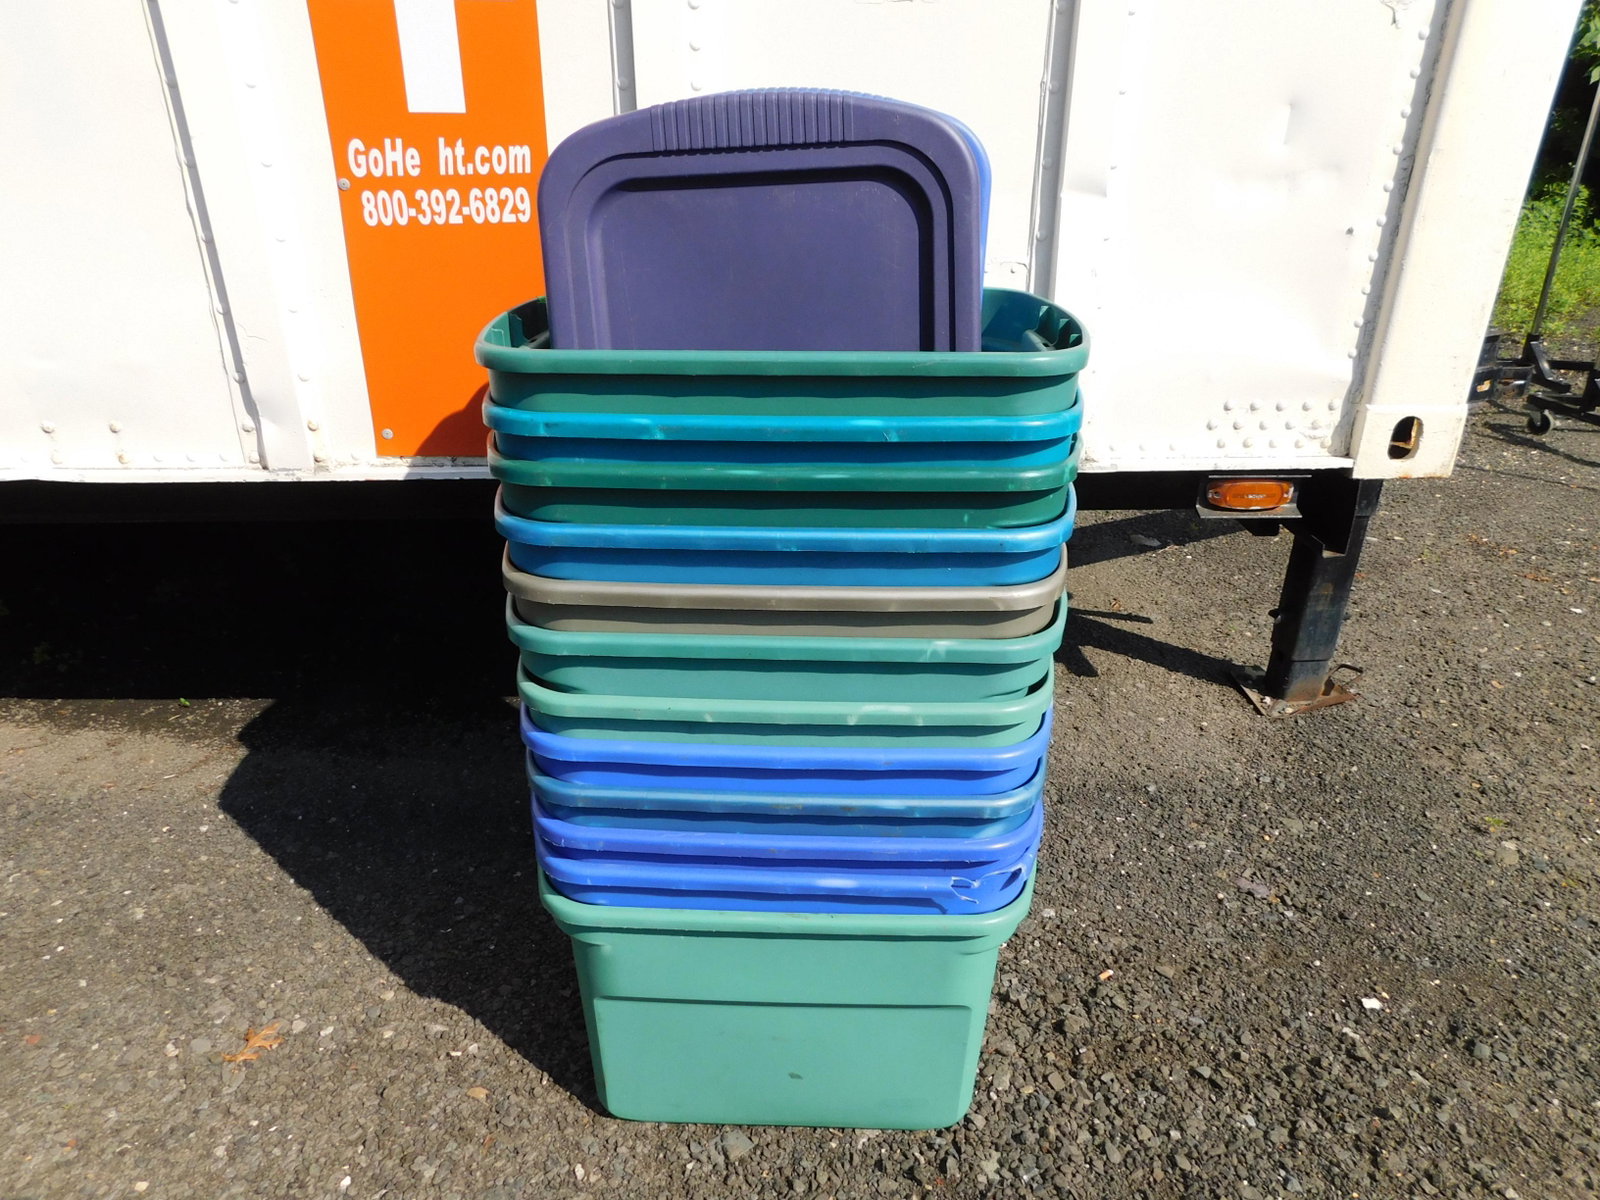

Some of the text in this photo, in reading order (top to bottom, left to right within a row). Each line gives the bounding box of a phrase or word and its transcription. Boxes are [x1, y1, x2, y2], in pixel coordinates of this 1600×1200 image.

[347, 136, 532, 178] GoHe ht.com
[361, 186, 532, 227] 800-392-6829
